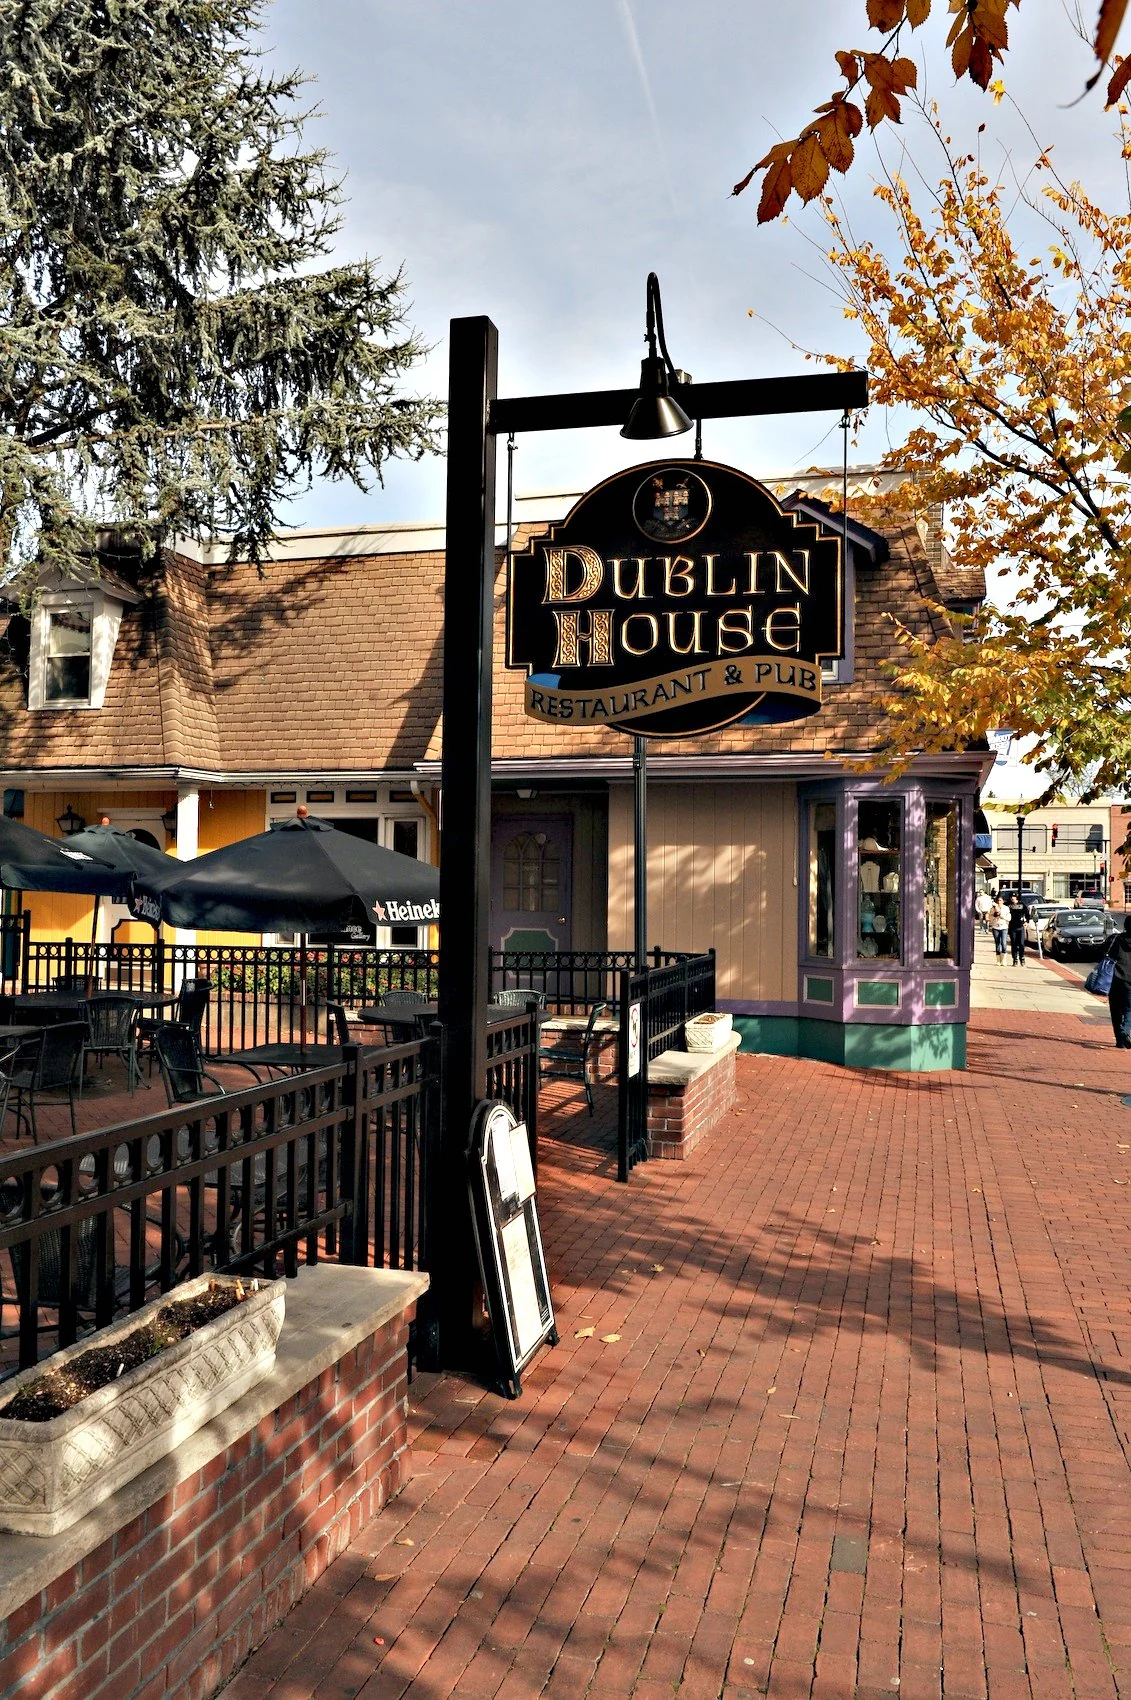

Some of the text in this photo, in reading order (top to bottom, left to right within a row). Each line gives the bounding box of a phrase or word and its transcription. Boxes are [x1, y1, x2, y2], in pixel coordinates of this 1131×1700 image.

[541, 545, 811, 604] DUBLIN
[552, 602, 801, 668] HOUSE
[530, 662, 817, 719] RESTAURANT & PUB
